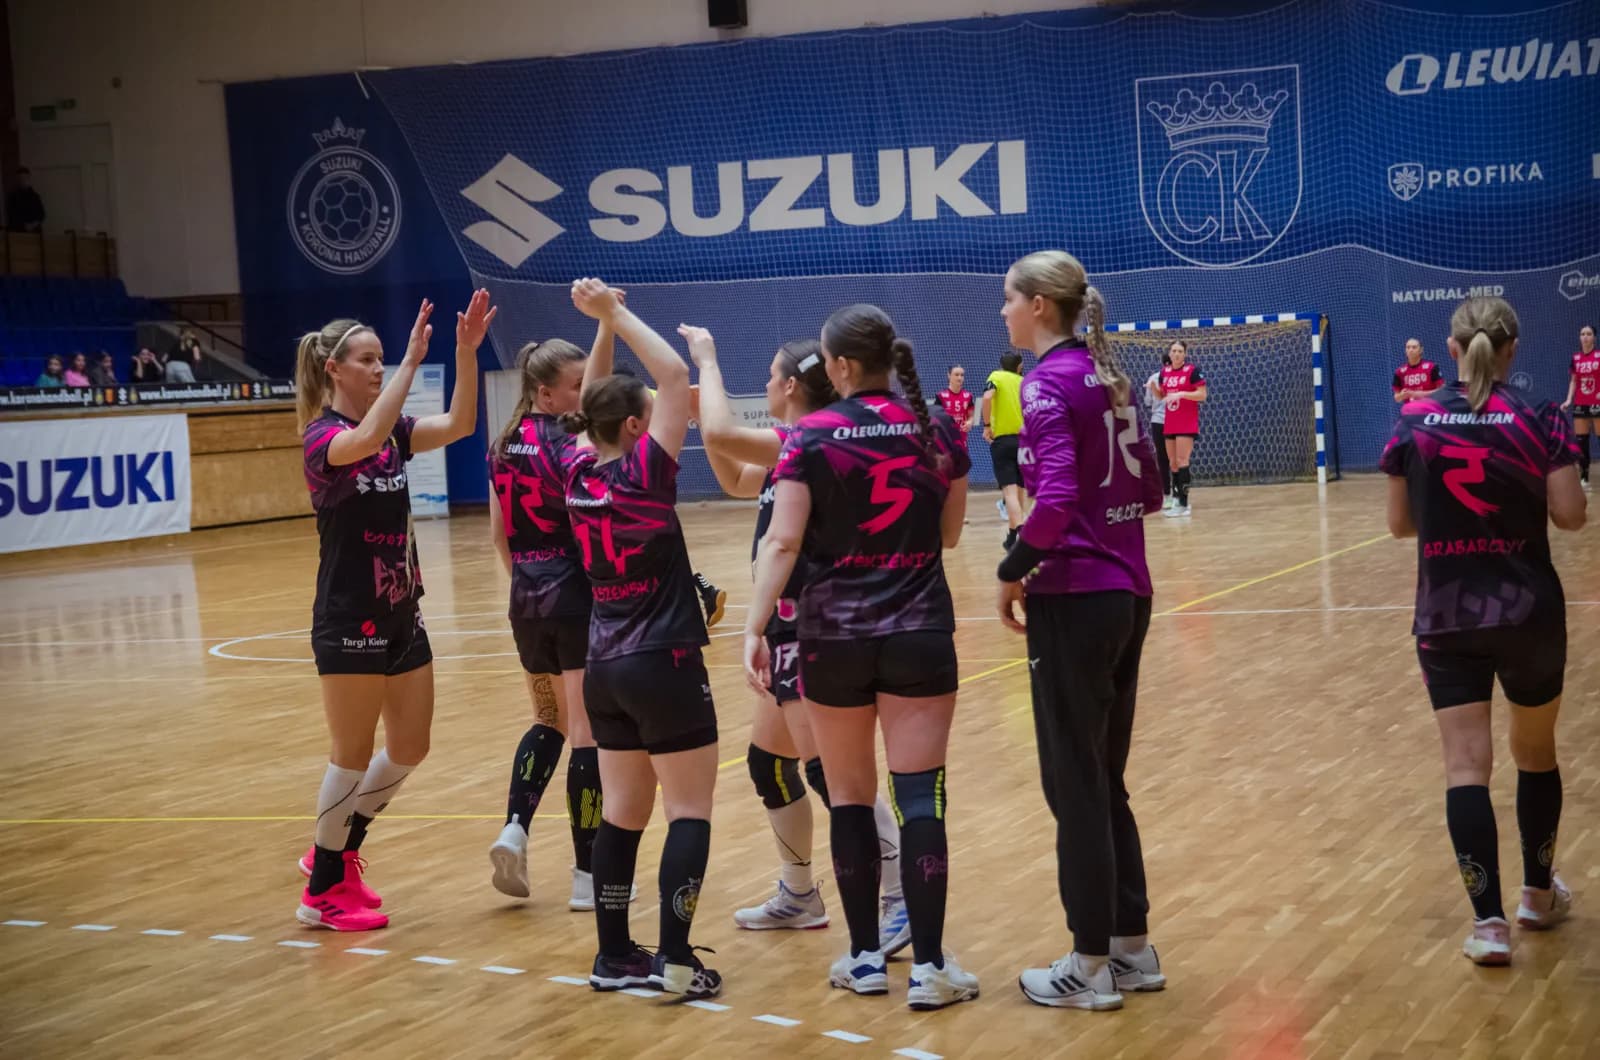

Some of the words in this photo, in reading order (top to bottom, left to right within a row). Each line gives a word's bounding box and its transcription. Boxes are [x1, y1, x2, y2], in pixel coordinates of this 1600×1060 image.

[319, 156, 363, 174] SUZUKI
[1428, 161, 1544, 189] PROFIKA
[588, 139, 1028, 243] SUZUKI
[300, 223, 341, 263] KORONA
[344, 216, 391, 264] HANDBALL
[1392, 285, 1504, 303] NATURAL-MED
[1442, 412, 1515, 425] LEWIATAN
[857, 455, 919, 536] 5
[342, 637, 366, 648] Targi
[774, 641, 800, 673] 17
